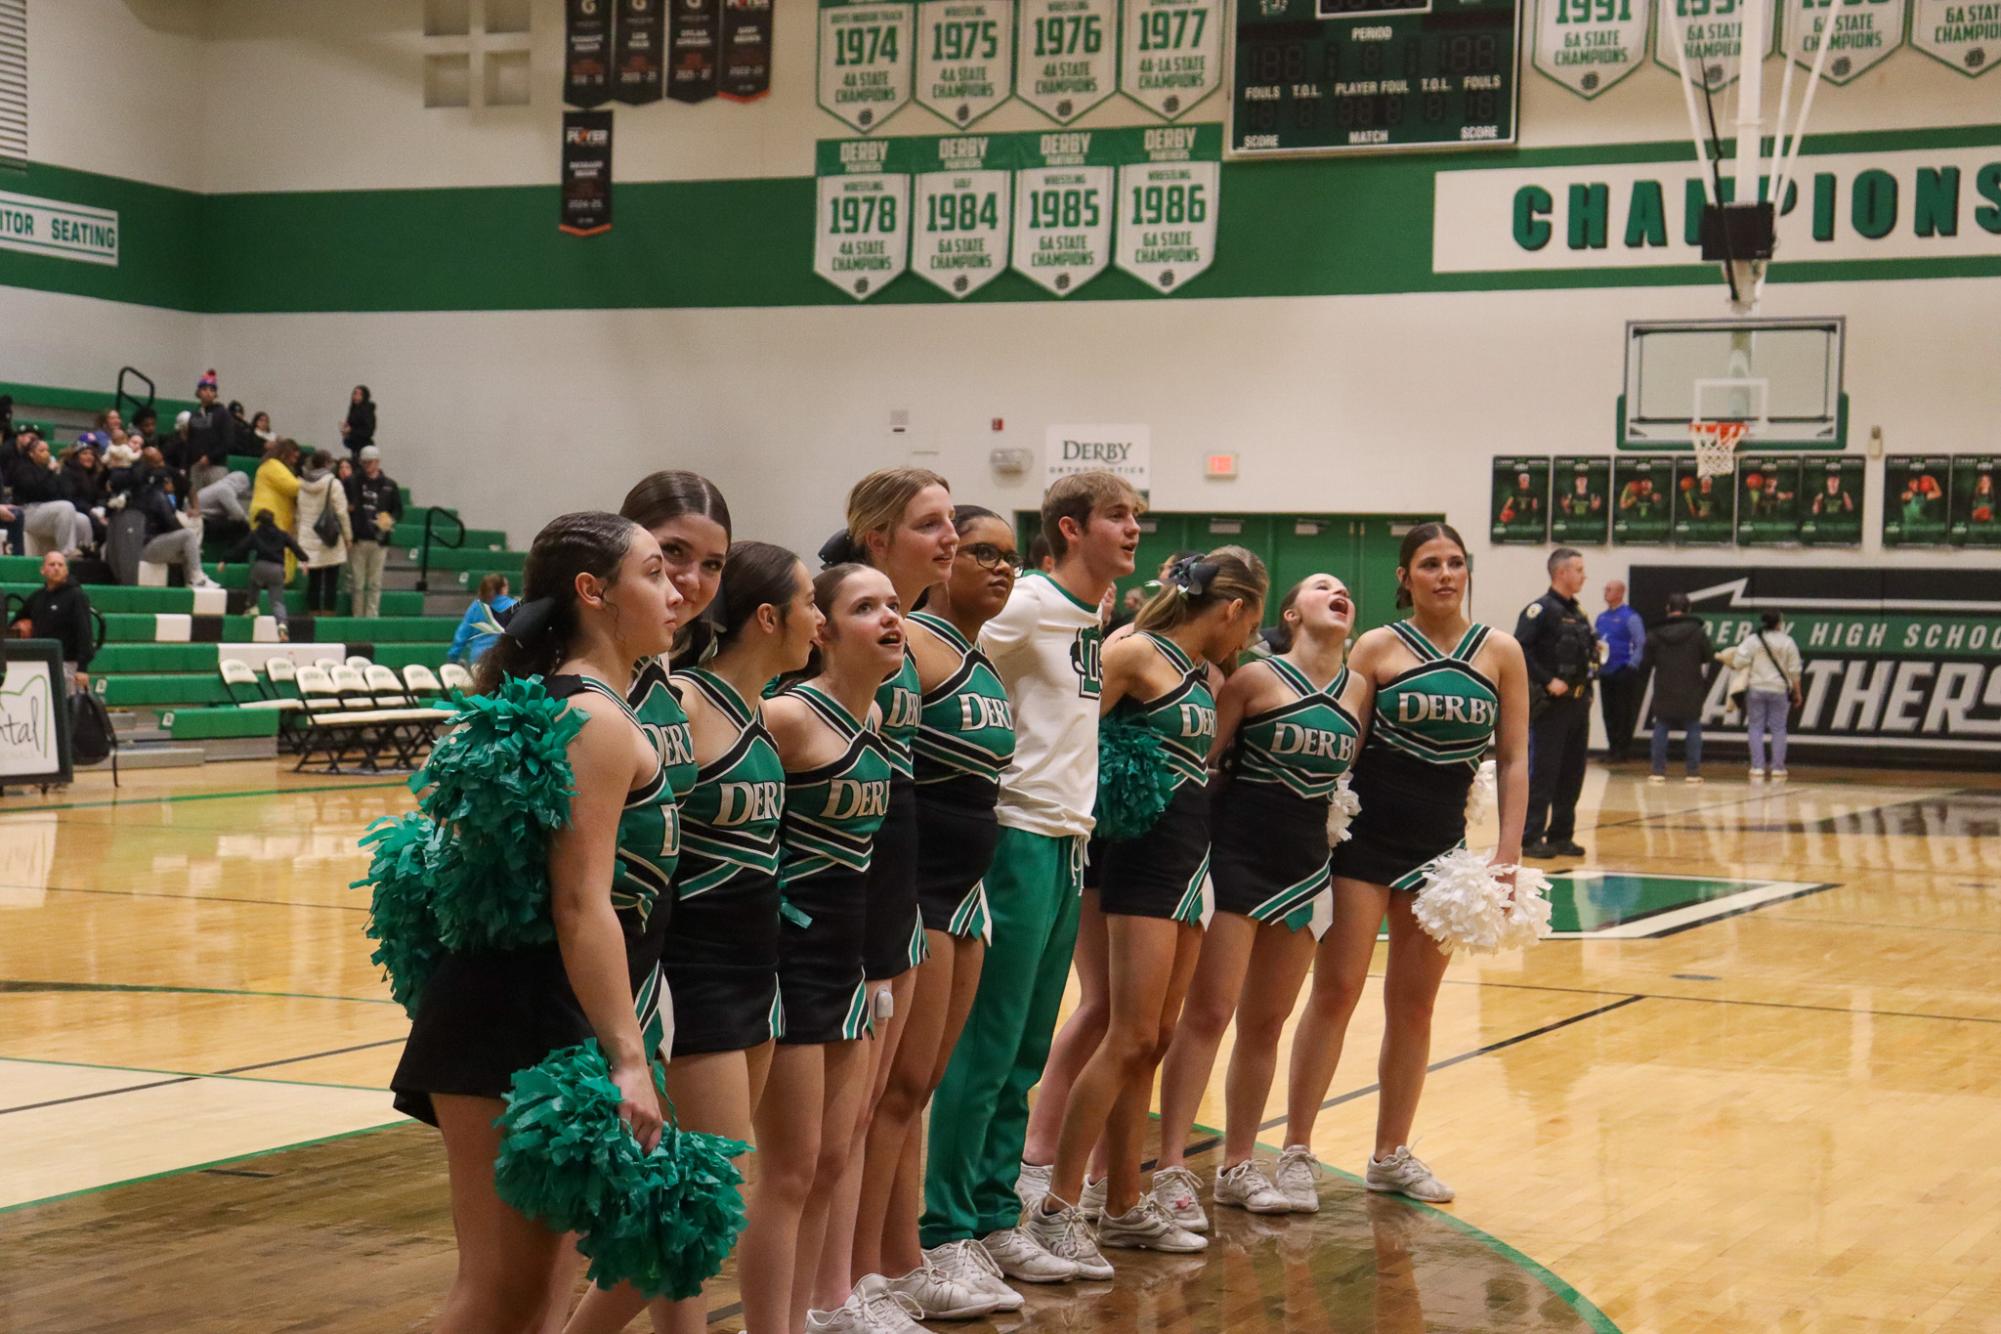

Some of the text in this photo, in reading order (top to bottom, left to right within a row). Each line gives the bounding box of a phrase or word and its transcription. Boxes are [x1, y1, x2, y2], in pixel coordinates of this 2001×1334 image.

[1835, 13, 1873, 31] STATE
[1946, 4, 2001, 23] 6A STAT
[1034, 15, 1102, 56] 1976
[1139, 8, 1208, 51] 1977
[1351, 26, 1392, 41] PERIOD
[1935, 23, 2001, 44] CHAMPIO
[835, 26, 897, 66] 1974
[932, 20, 998, 61] 1975
[1564, 30, 1620, 48] 6A STATE
[1803, 31, 1882, 51] CHMPIONS
[1174, 55, 1206, 71] STATE
[1554, 48, 1628, 66] CHAMPIONS
[940, 66, 987, 82] 4A STATE
[1042, 61, 1091, 77] 4A STATE
[843, 70, 889, 87] 4A STATE
[1035, 78, 1098, 95] CHAMPIONS
[1139, 73, 1205, 90] CHAMPIONS
[1334, 79, 1409, 96] PLAYER FOUL
[1463, 75, 1501, 90] FOULS
[835, 87, 896, 103] CHAMPIONS
[932, 82, 994, 99] CHAMPIONS
[1245, 85, 1280, 100] FOULS
[1143, 127, 1197, 151] DERBY
[1244, 134, 1279, 148] SCORE
[1348, 130, 1388, 144] MATCH
[1461, 125, 1498, 139] SCORE
[840, 141, 889, 163] DERBY
[938, 136, 989, 160] DERBY
[1040, 132, 1092, 155] DERBY
[926, 192, 998, 232] 1984
[1029, 188, 1099, 229] 1985
[1132, 184, 1207, 225] 1986
[829, 194, 897, 234] 1978
[51, 218, 115, 249] SEATING
[1038, 235, 1087, 250] 6A STATE
[1142, 231, 1193, 246] 6A STATE
[839, 240, 886, 255] 4A STATE
[938, 237, 985, 253] 6A STATE
[832, 256, 892, 271] CHAMPIONS
[930, 254, 993, 270] CHAMPIONS
[1031, 251, 1095, 267] CHAMPIONS
[1135, 247, 1200, 263] CHAMPIONS
[1809, 622, 1888, 648] HIGH
[887, 686, 921, 727] DER
[1398, 691, 1498, 727] DERBY
[1270, 722, 1357, 761] DERB
[711, 782, 785, 826] DER
[819, 778, 890, 820] DER
